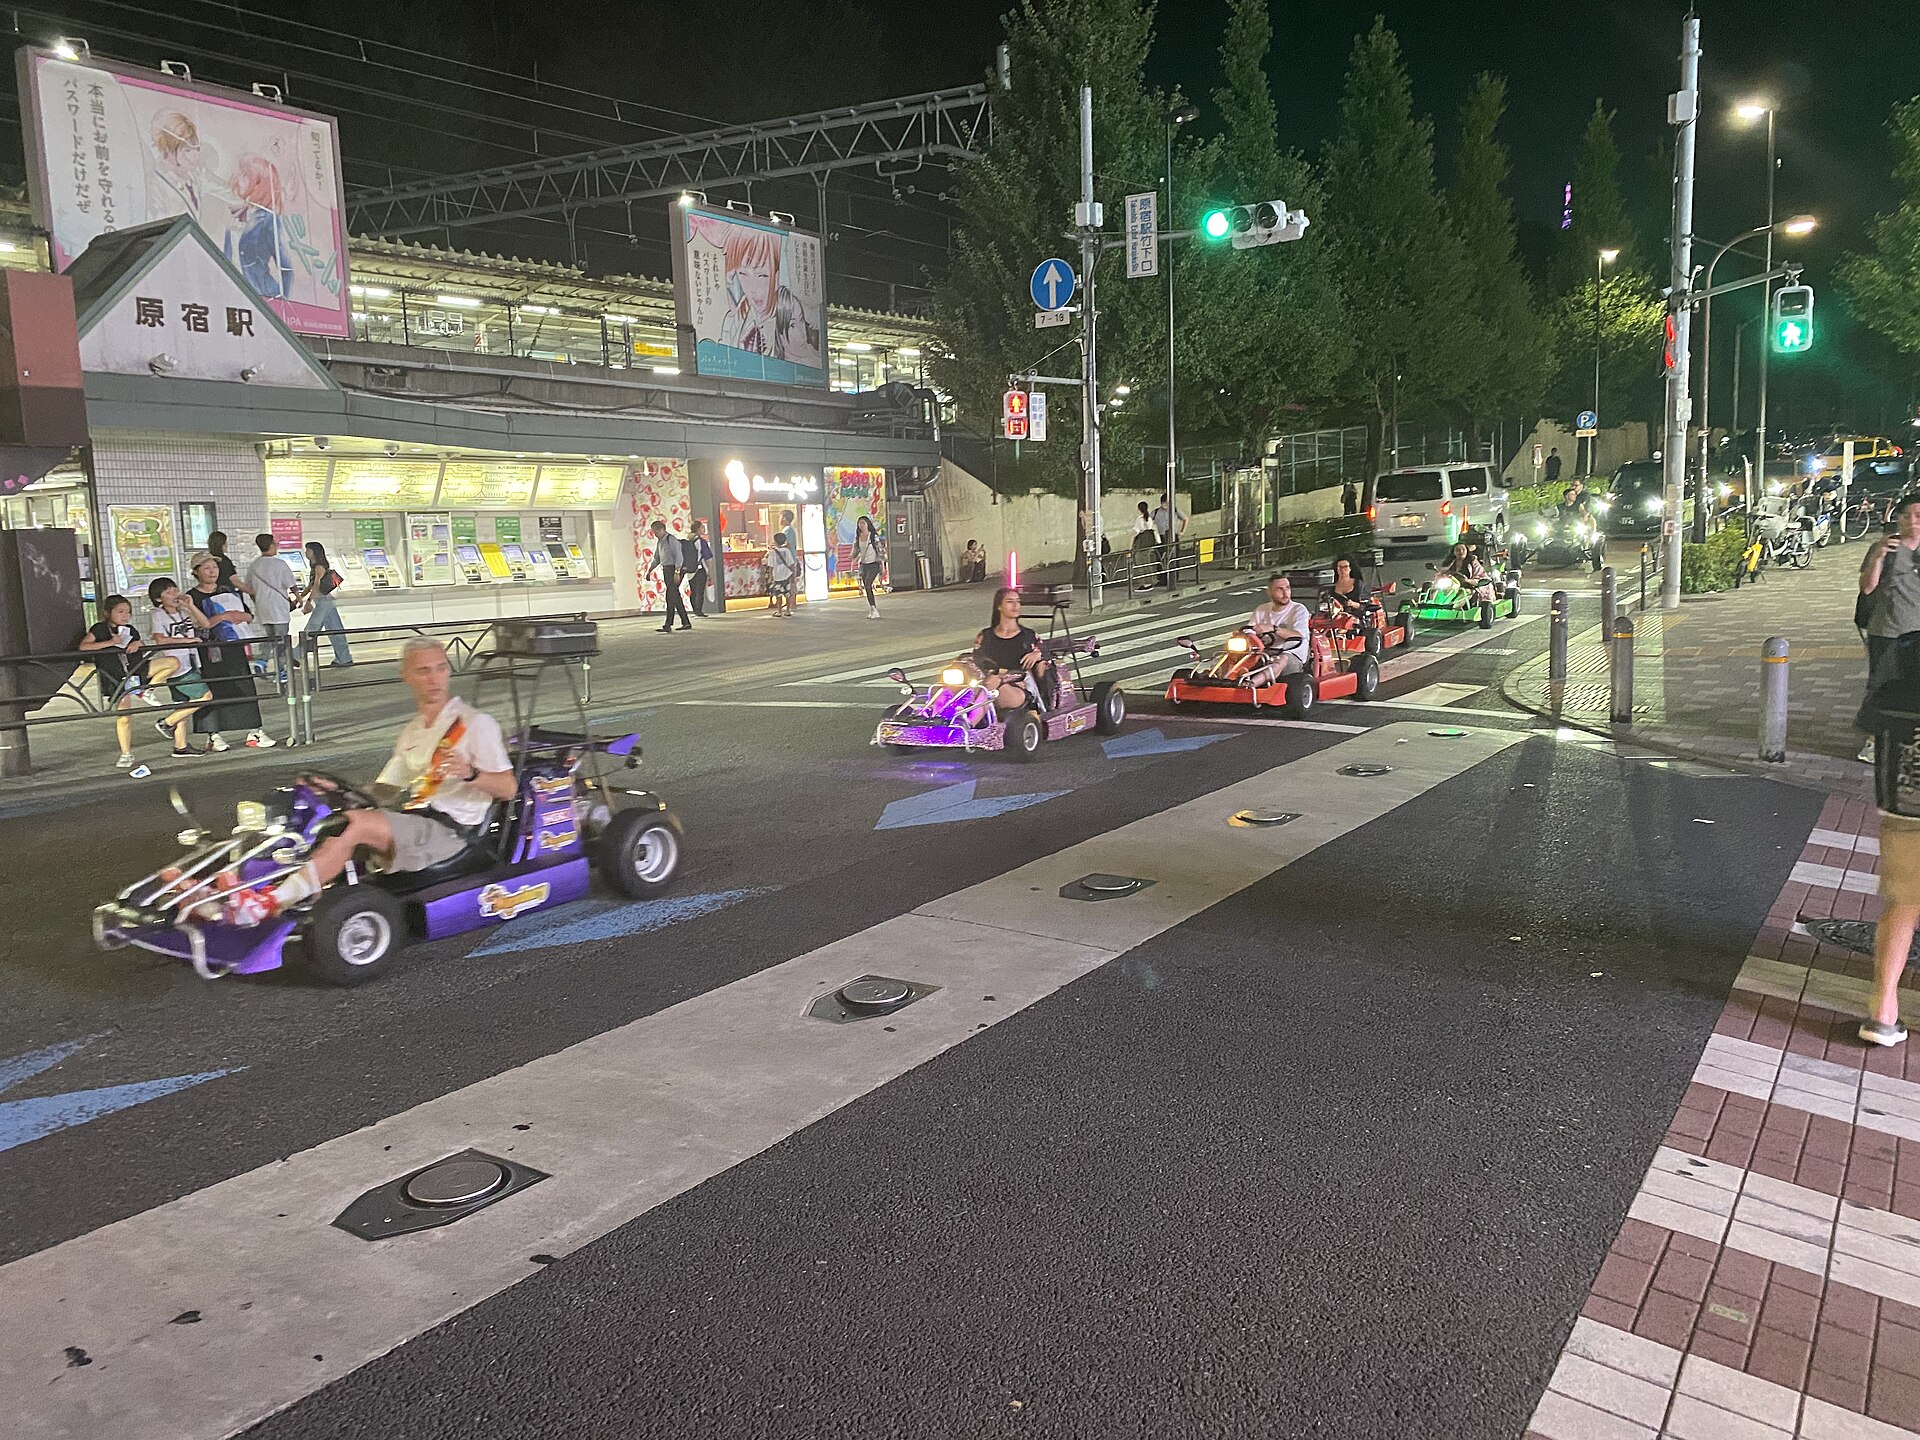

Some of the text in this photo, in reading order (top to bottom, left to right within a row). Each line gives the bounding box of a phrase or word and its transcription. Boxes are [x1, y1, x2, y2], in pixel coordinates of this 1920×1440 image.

[63, 78, 91, 214] パスワードだけだぜ
[703, 251, 712, 306] パスワードの
[136, 296, 254, 337] 原宿駅
